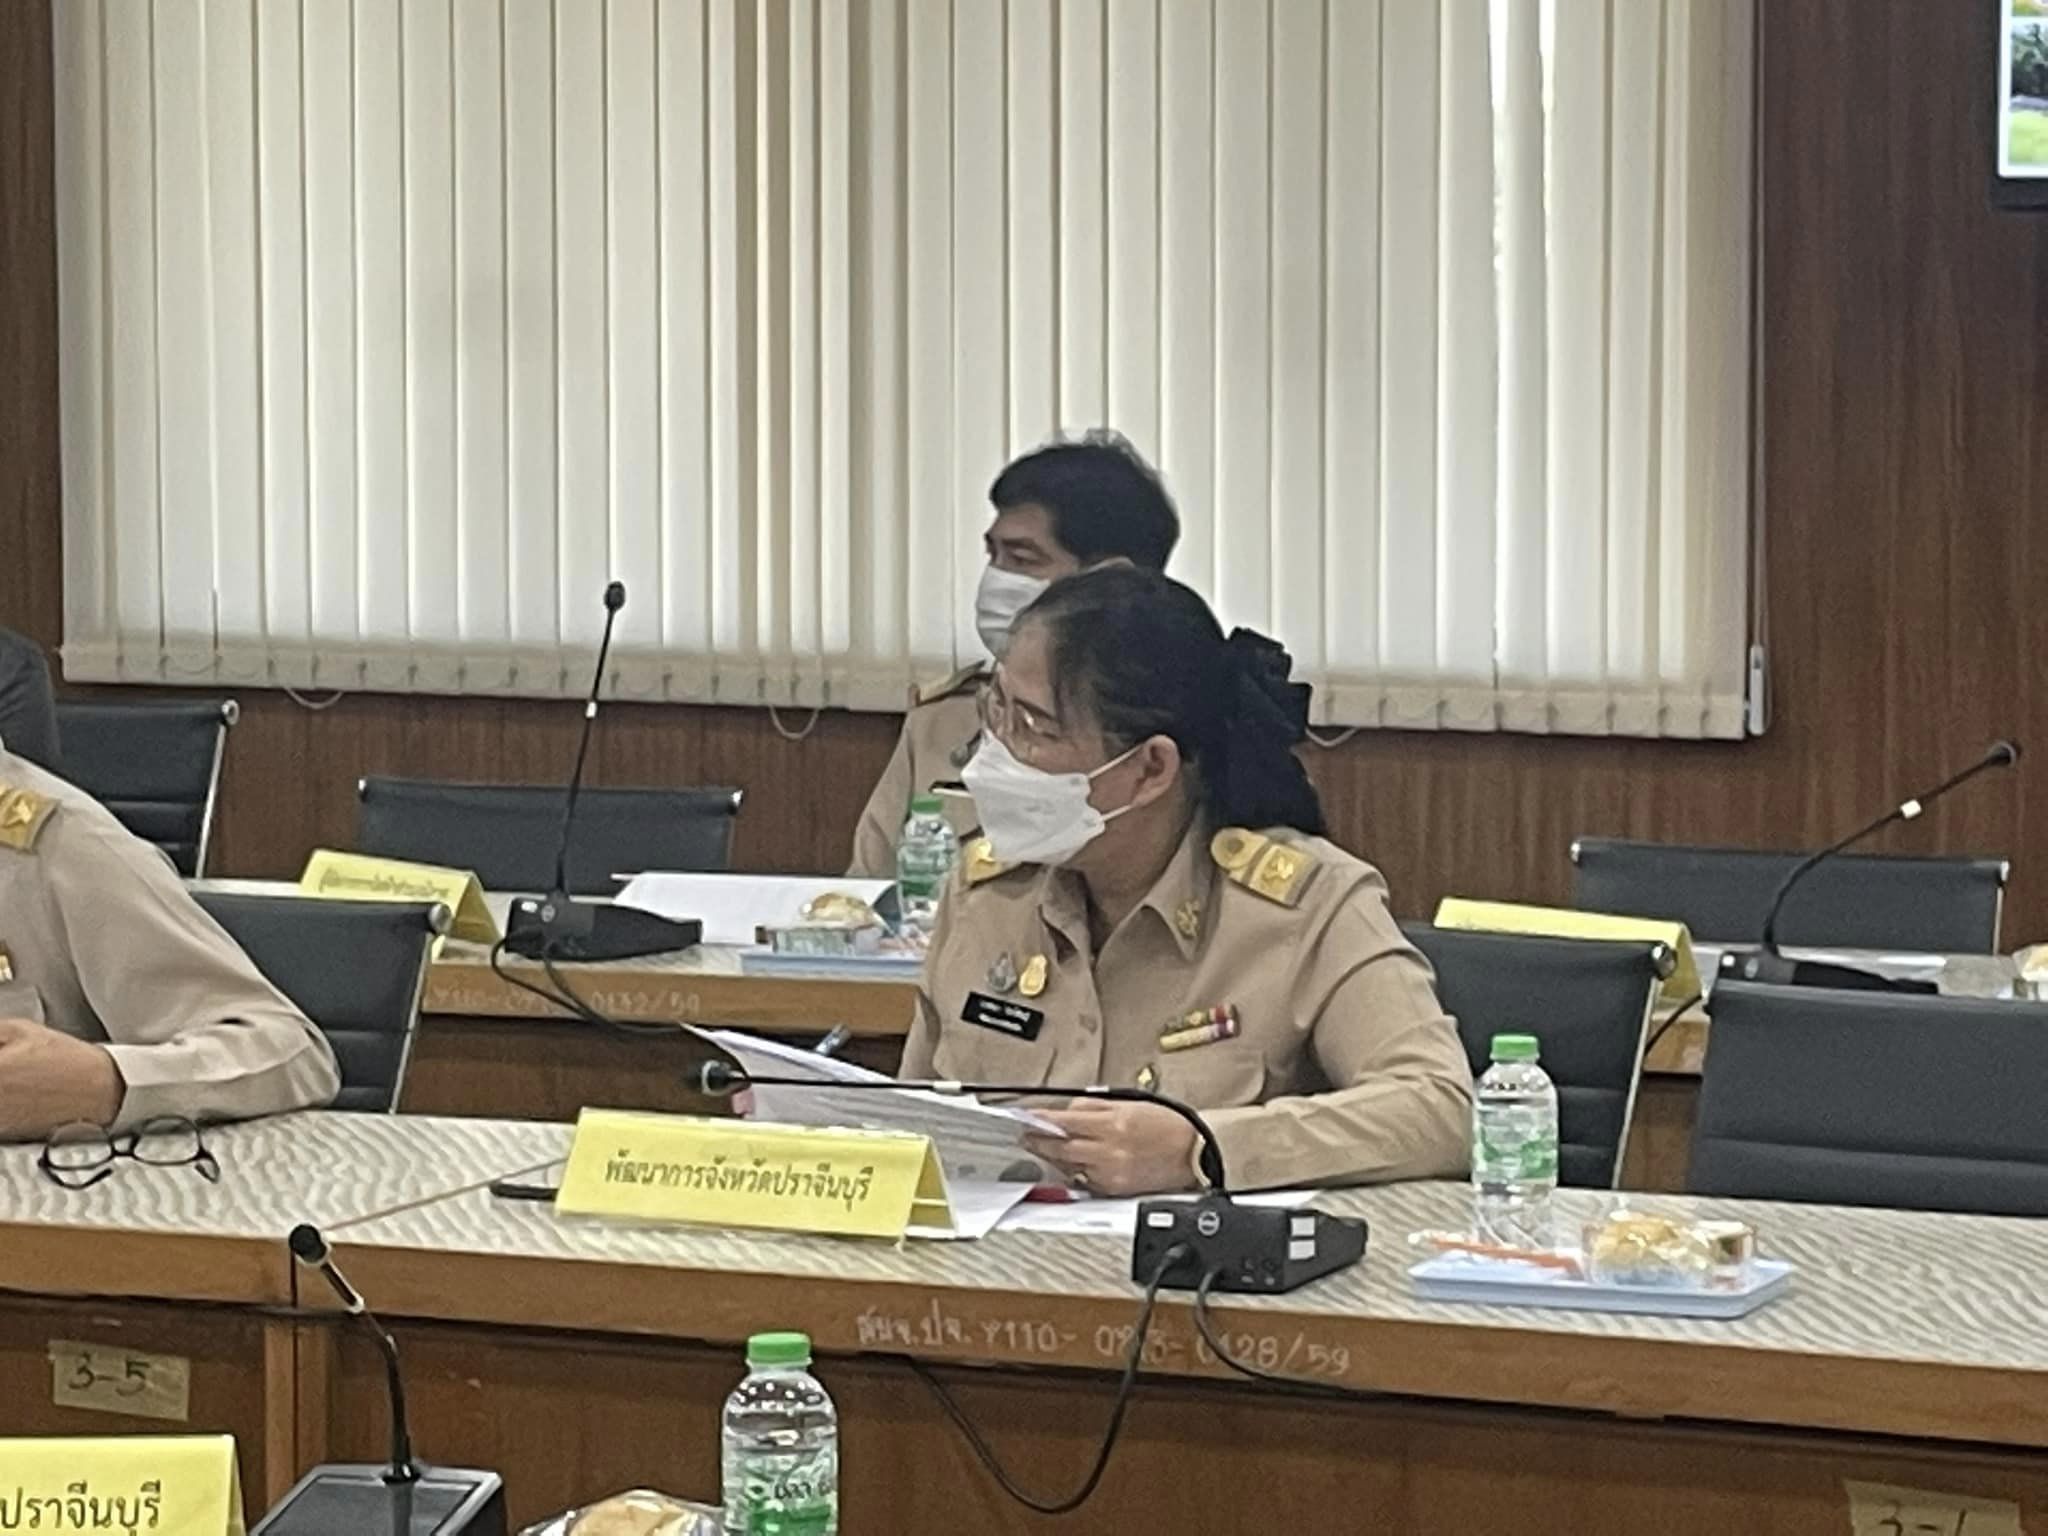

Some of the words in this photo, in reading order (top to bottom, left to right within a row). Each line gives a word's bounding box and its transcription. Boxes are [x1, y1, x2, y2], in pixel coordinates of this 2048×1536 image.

[605, 1149, 874, 1212] พัฒนาการจังหวัดปราจีนบุรี
[68, 1350, 150, 1397] 3-5
